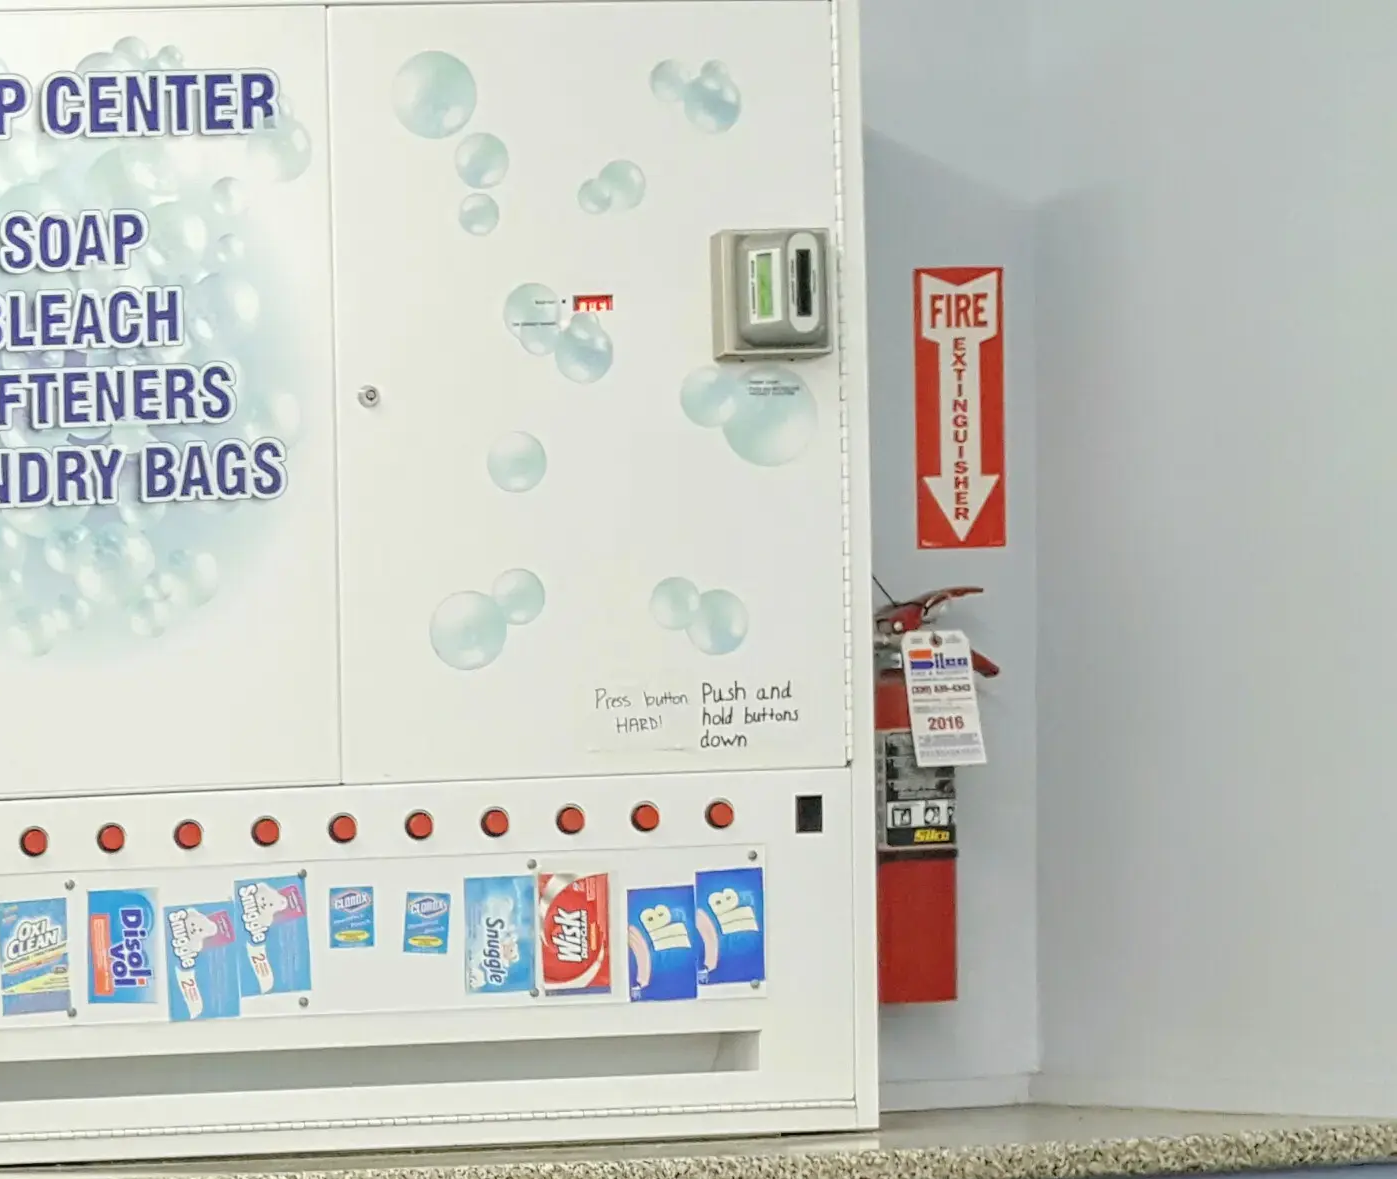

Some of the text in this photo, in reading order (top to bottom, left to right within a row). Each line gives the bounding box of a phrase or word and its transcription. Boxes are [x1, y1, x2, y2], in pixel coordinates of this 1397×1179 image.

[45, 73, 278, 135] CENTER
[3, 213, 146, 270] SOAP
[929, 293, 988, 329] FIRE
[951, 337, 970, 521] EXTINGUISHER
[144, 441, 284, 499] BAGS
[595, 688, 688, 709] Press button
[702, 680, 793, 702] Push and
[616, 715, 663, 733] HARD!
[702, 706, 799, 726] hold buttons
[928, 715, 965, 731] 2016
[700, 730, 747, 748] down
[7, 927, 61, 960] CLEAN
[18, 918, 48, 941] OXI
[551, 907, 583, 964] Wisk
[484, 917, 505, 985] Snuggle
